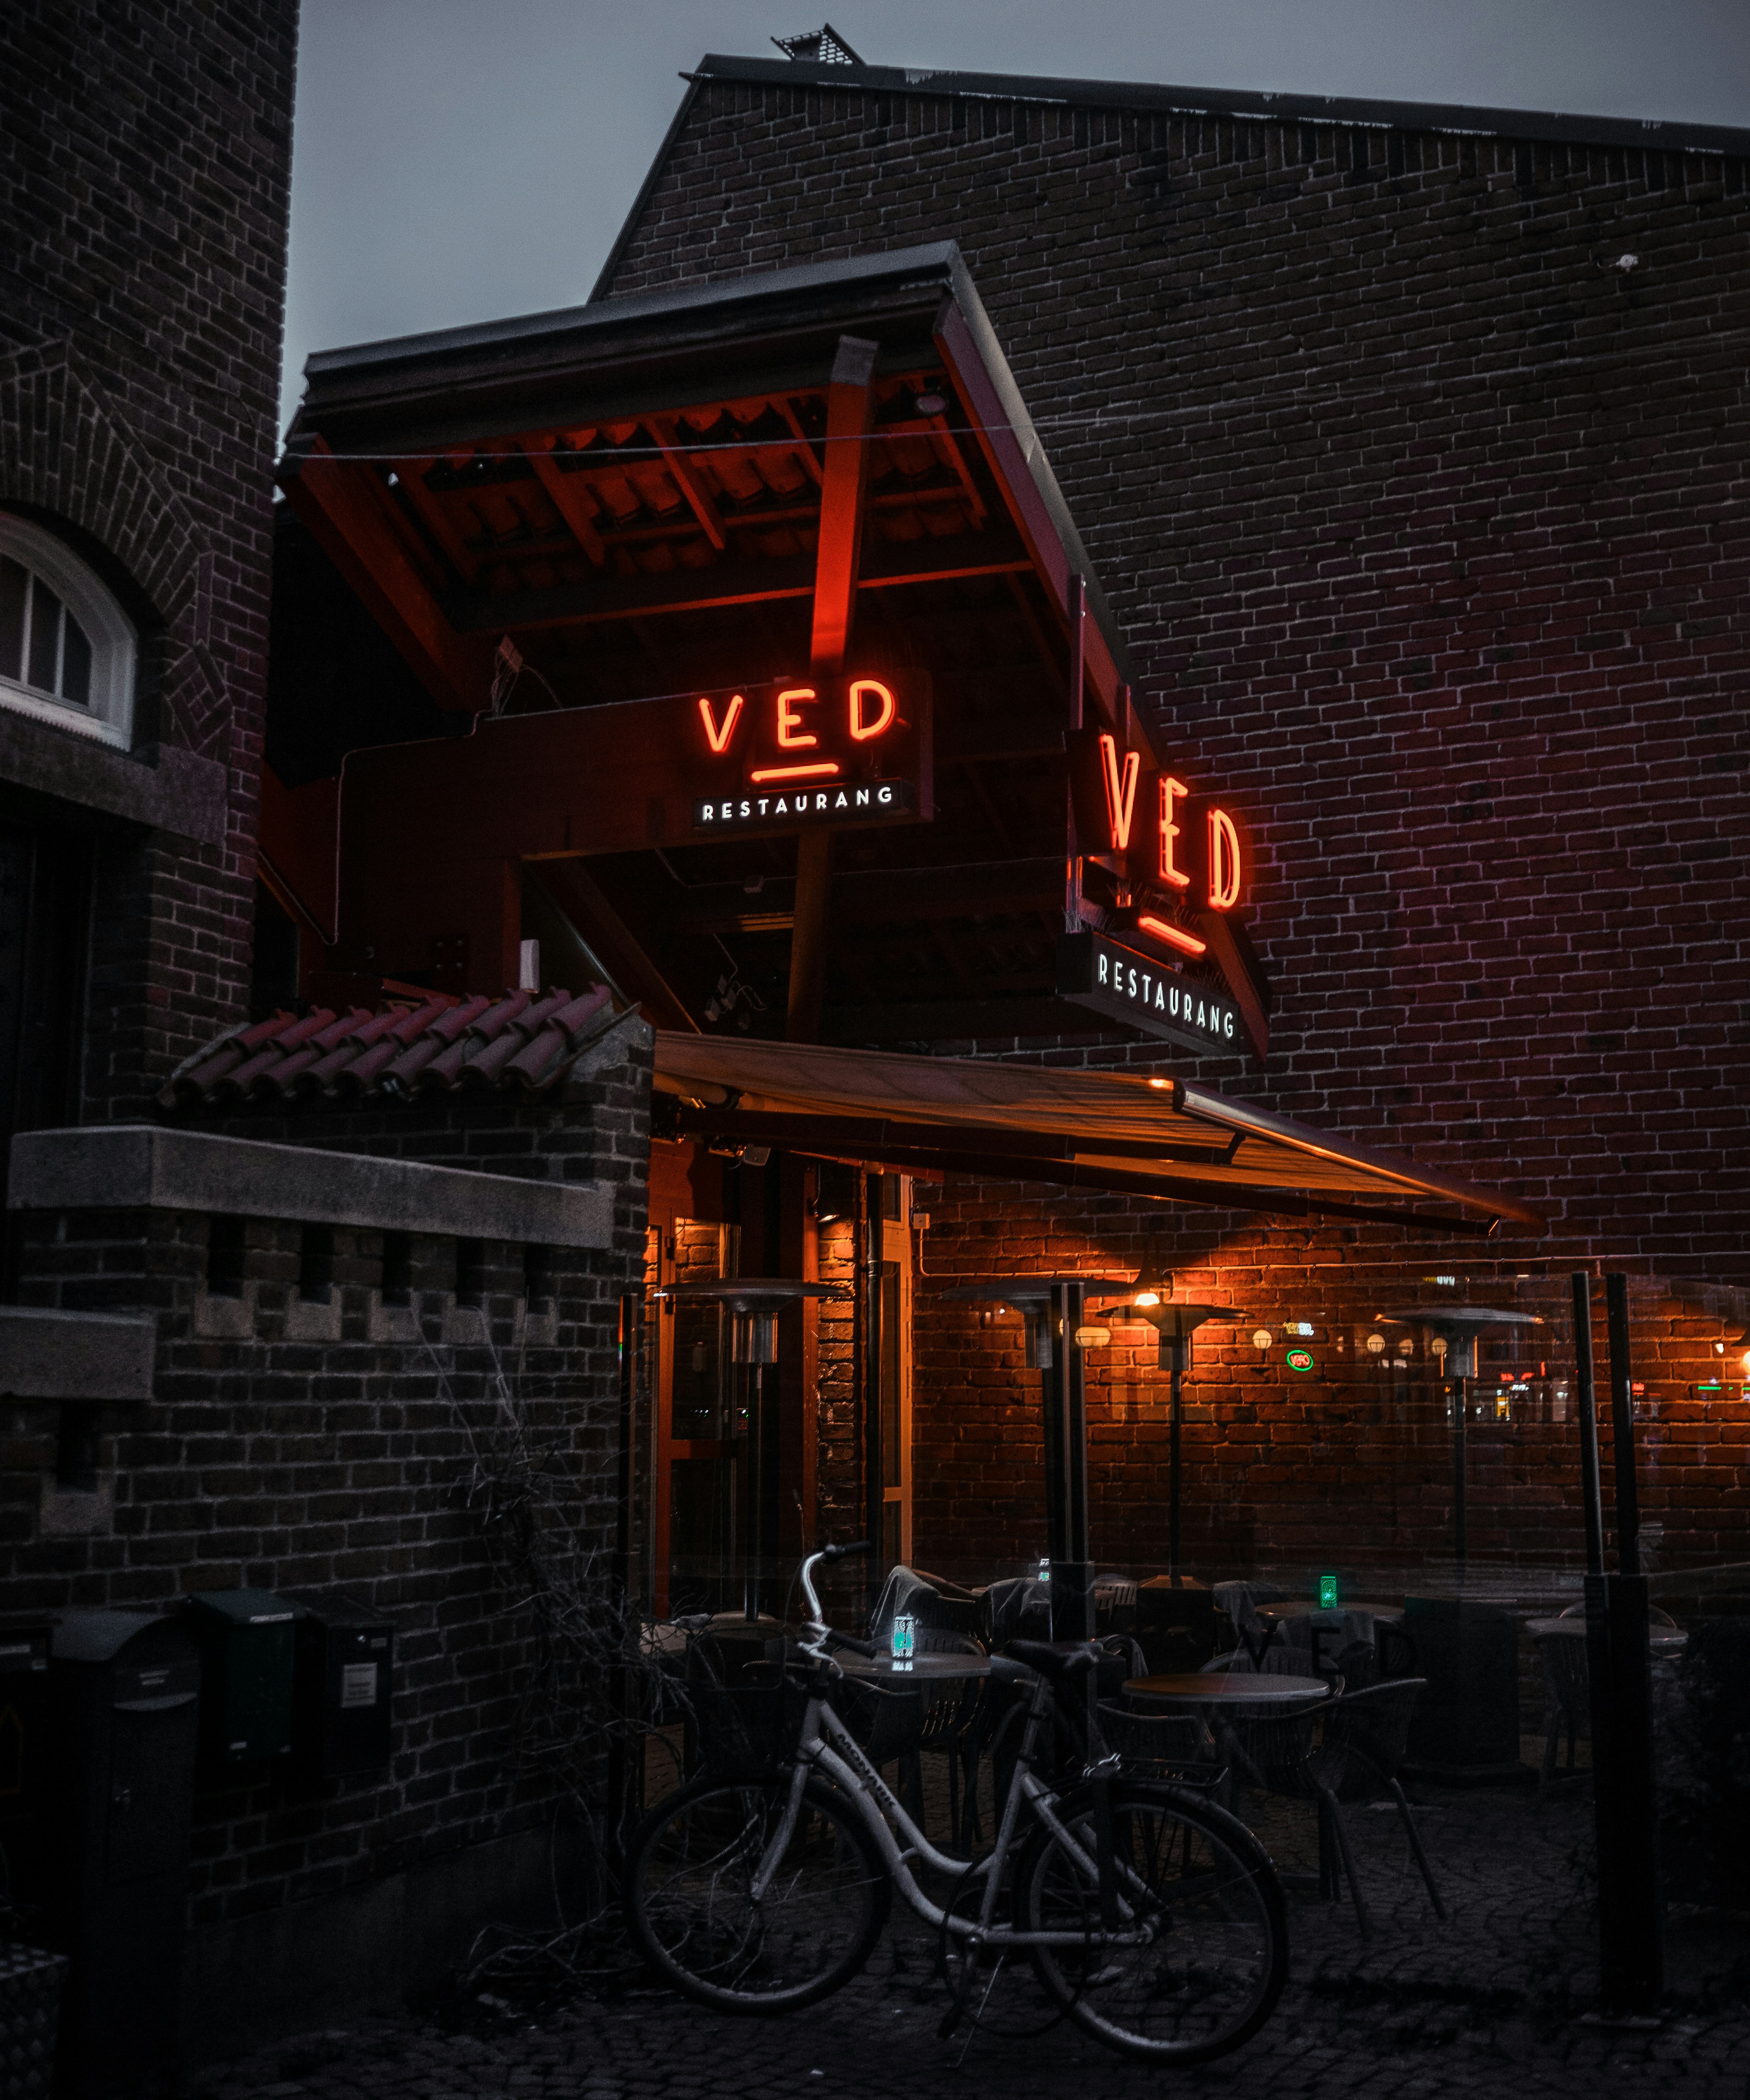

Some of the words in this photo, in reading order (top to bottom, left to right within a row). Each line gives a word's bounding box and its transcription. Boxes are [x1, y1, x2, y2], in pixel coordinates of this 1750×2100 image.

[700, 679, 895, 752] VED
[703, 787, 892, 820] RESTAURANG
[1100, 734, 1241, 908] VED
[1099, 955, 1233, 1039] RESTAURANG
[1238, 1622, 1418, 1676] VED
[837, 1733, 895, 1808] MONARK
